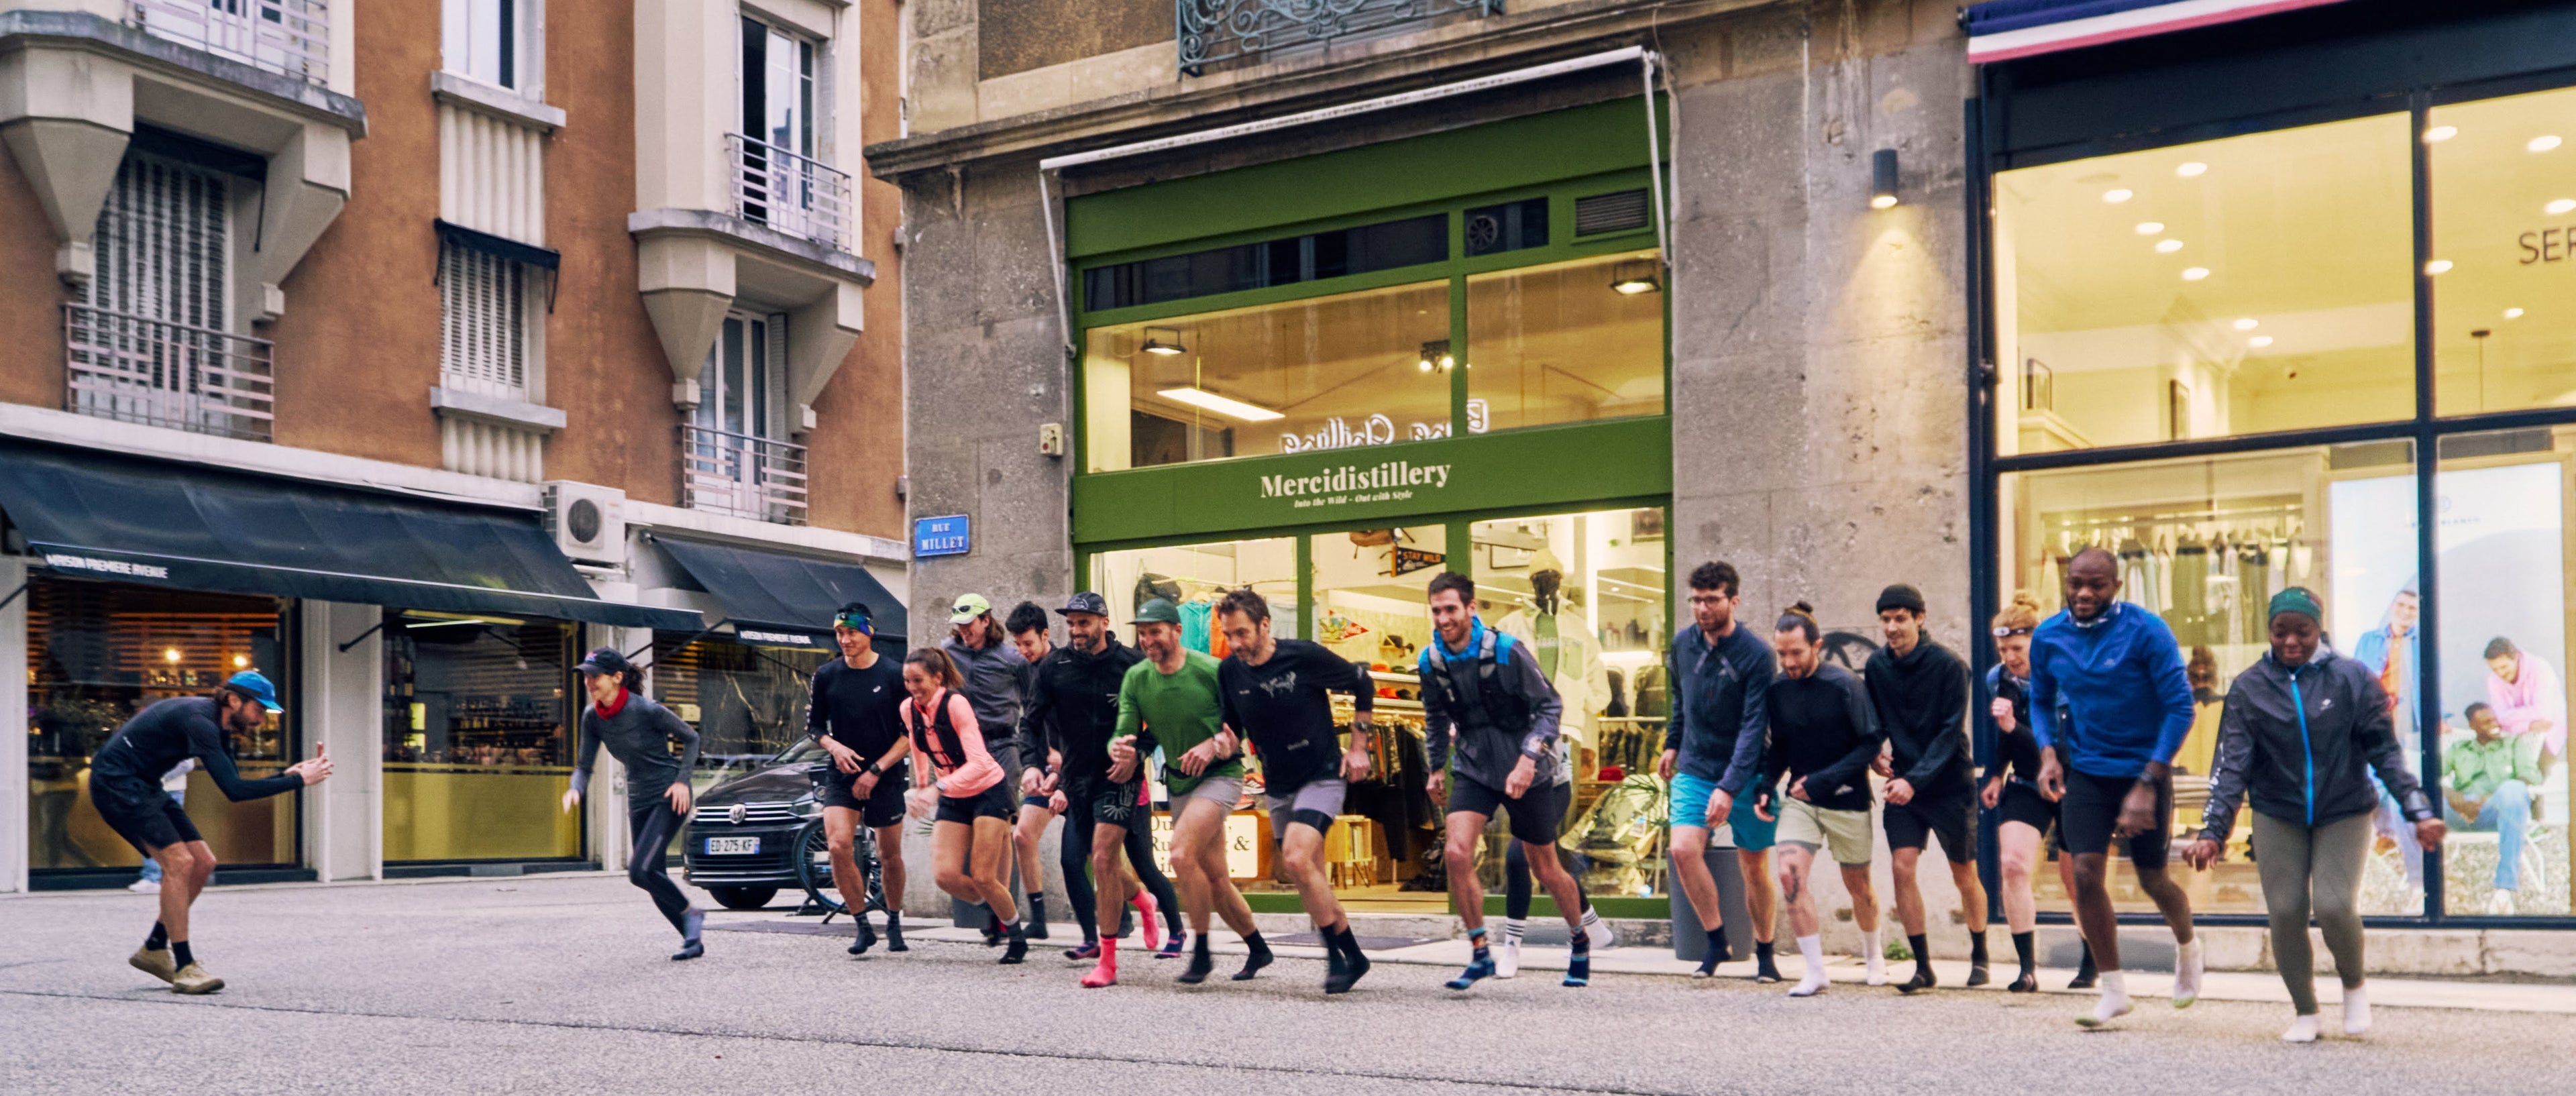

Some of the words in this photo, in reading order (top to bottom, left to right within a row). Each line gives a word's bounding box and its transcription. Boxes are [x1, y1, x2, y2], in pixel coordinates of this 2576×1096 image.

[1260, 461, 1451, 497] Mercidistillery
[1294, 499, 1311, 508] Into
[1312, 498, 1326, 506] the
[1328, 495, 1348, 505] Wild
[1354, 494, 1371, 503] Out
[1372, 491, 1391, 501] with
[1392, 490, 1413, 501] Style
[931, 523, 951, 533] RUE
[1403, 551, 1421, 560] STAY
[710, 839, 753, 852] ED-275-KF
